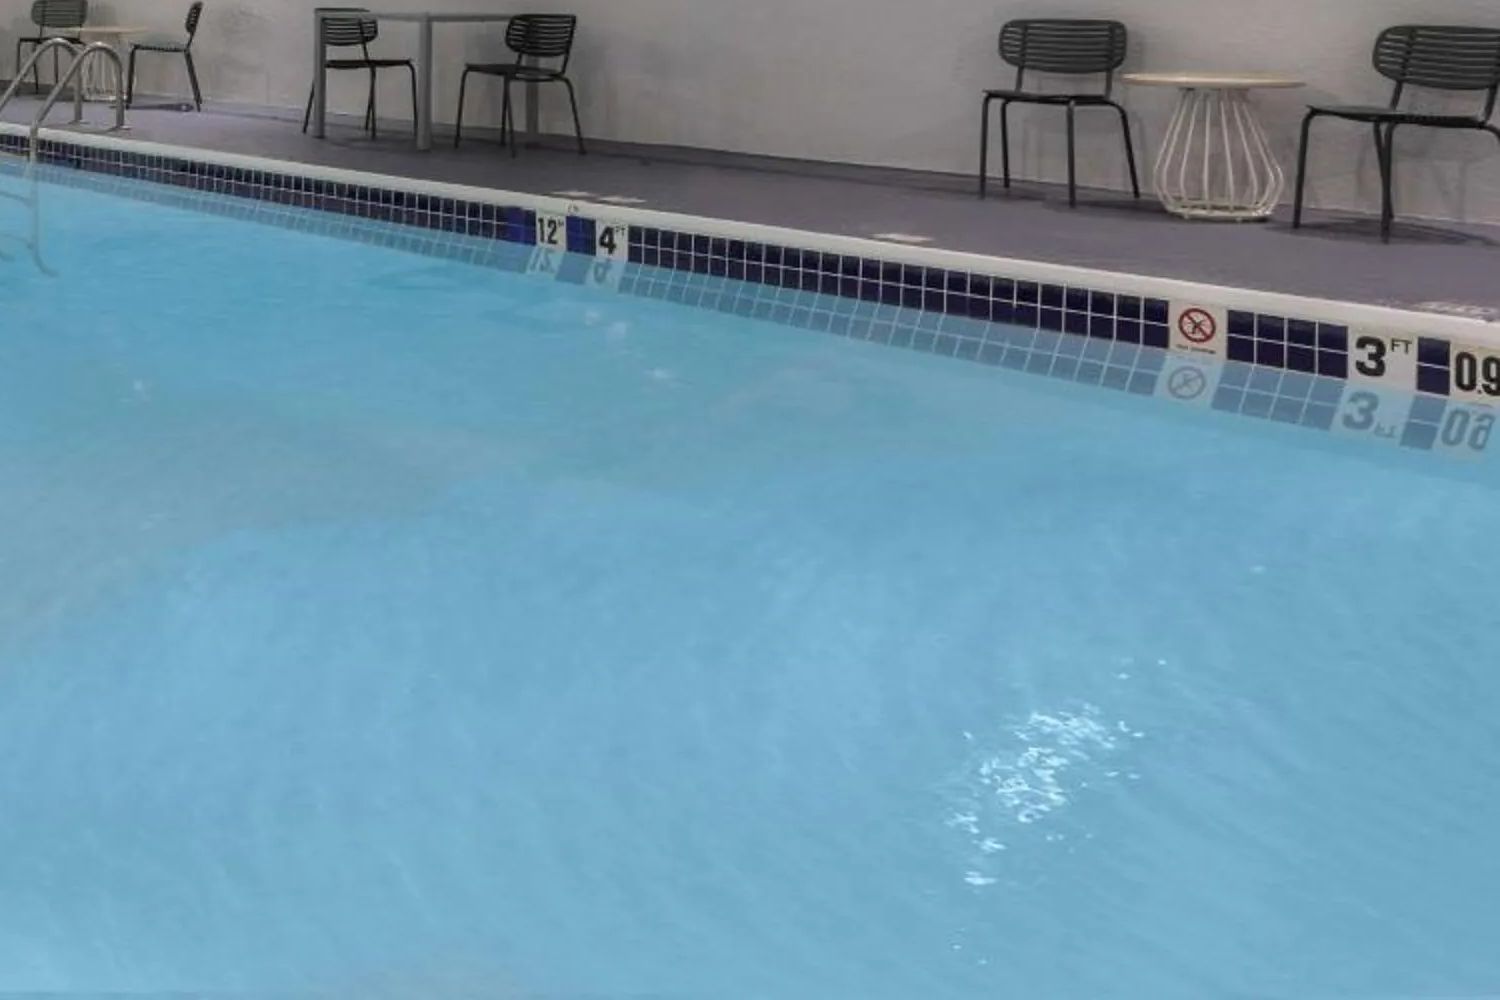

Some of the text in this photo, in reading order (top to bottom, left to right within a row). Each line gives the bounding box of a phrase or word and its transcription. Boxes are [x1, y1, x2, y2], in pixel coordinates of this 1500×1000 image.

[599, 225, 617, 255] 4
[1355, 335, 1412, 377] 3 FT
[1455, 351, 1500, 397] 0.9
